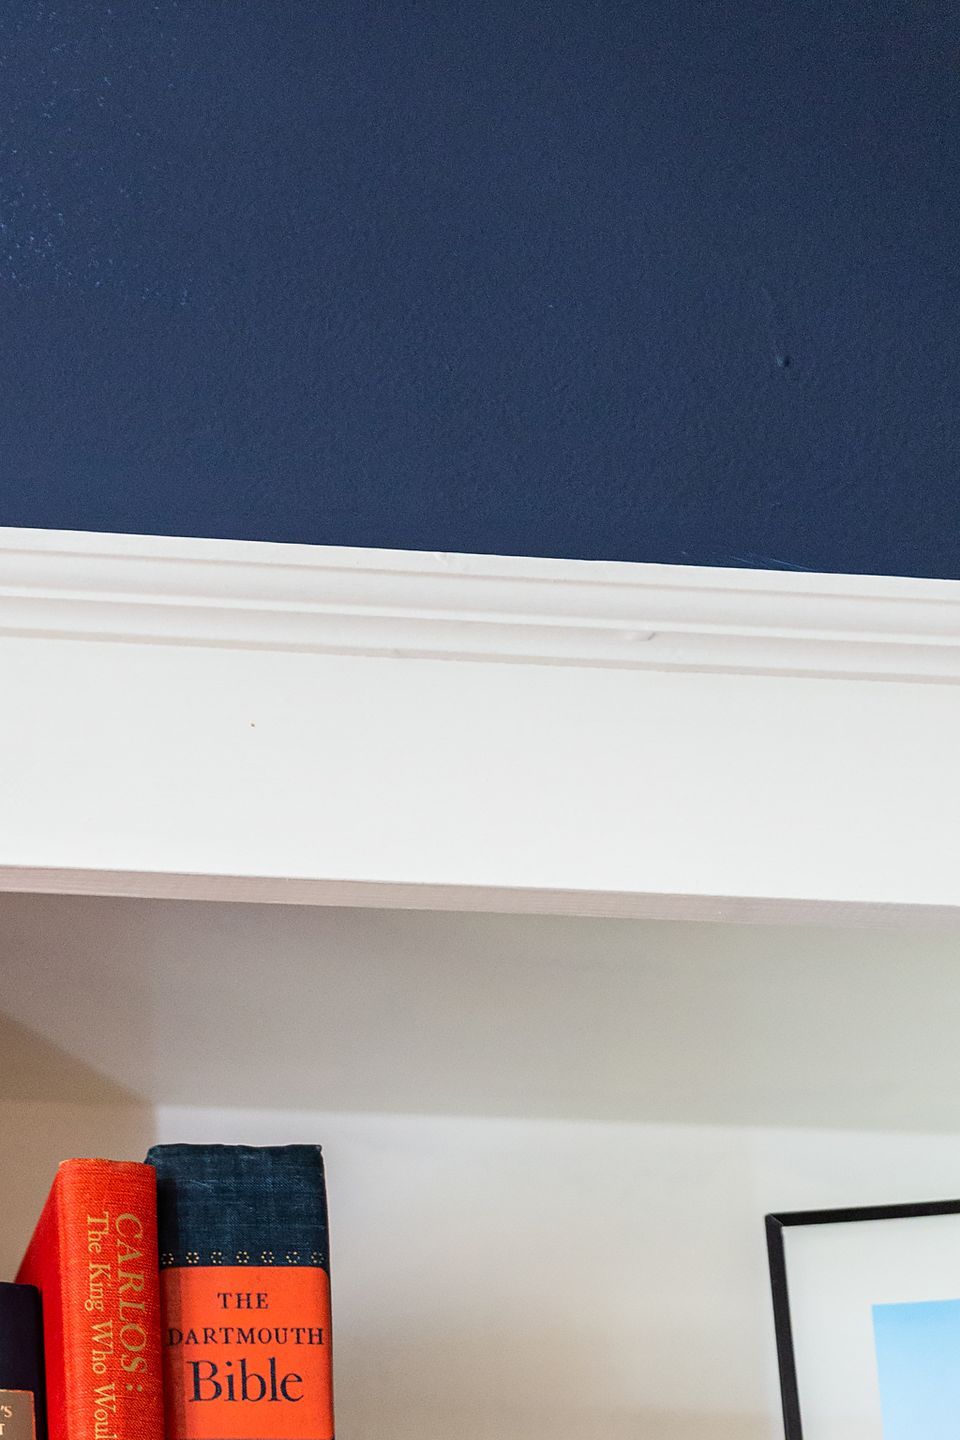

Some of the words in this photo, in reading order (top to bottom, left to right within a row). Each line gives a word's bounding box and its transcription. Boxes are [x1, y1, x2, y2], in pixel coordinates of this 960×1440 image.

[87, 1211, 109, 1254] The
[84, 1263, 111, 1312] King
[115, 1212, 147, 1392] CARLOS:
[217, 1292, 269, 1309] THE
[90, 1319, 113, 1374] Who
[167, 1327, 324, 1345] DARTMOUTH
[187, 1357, 304, 1402] Bible
